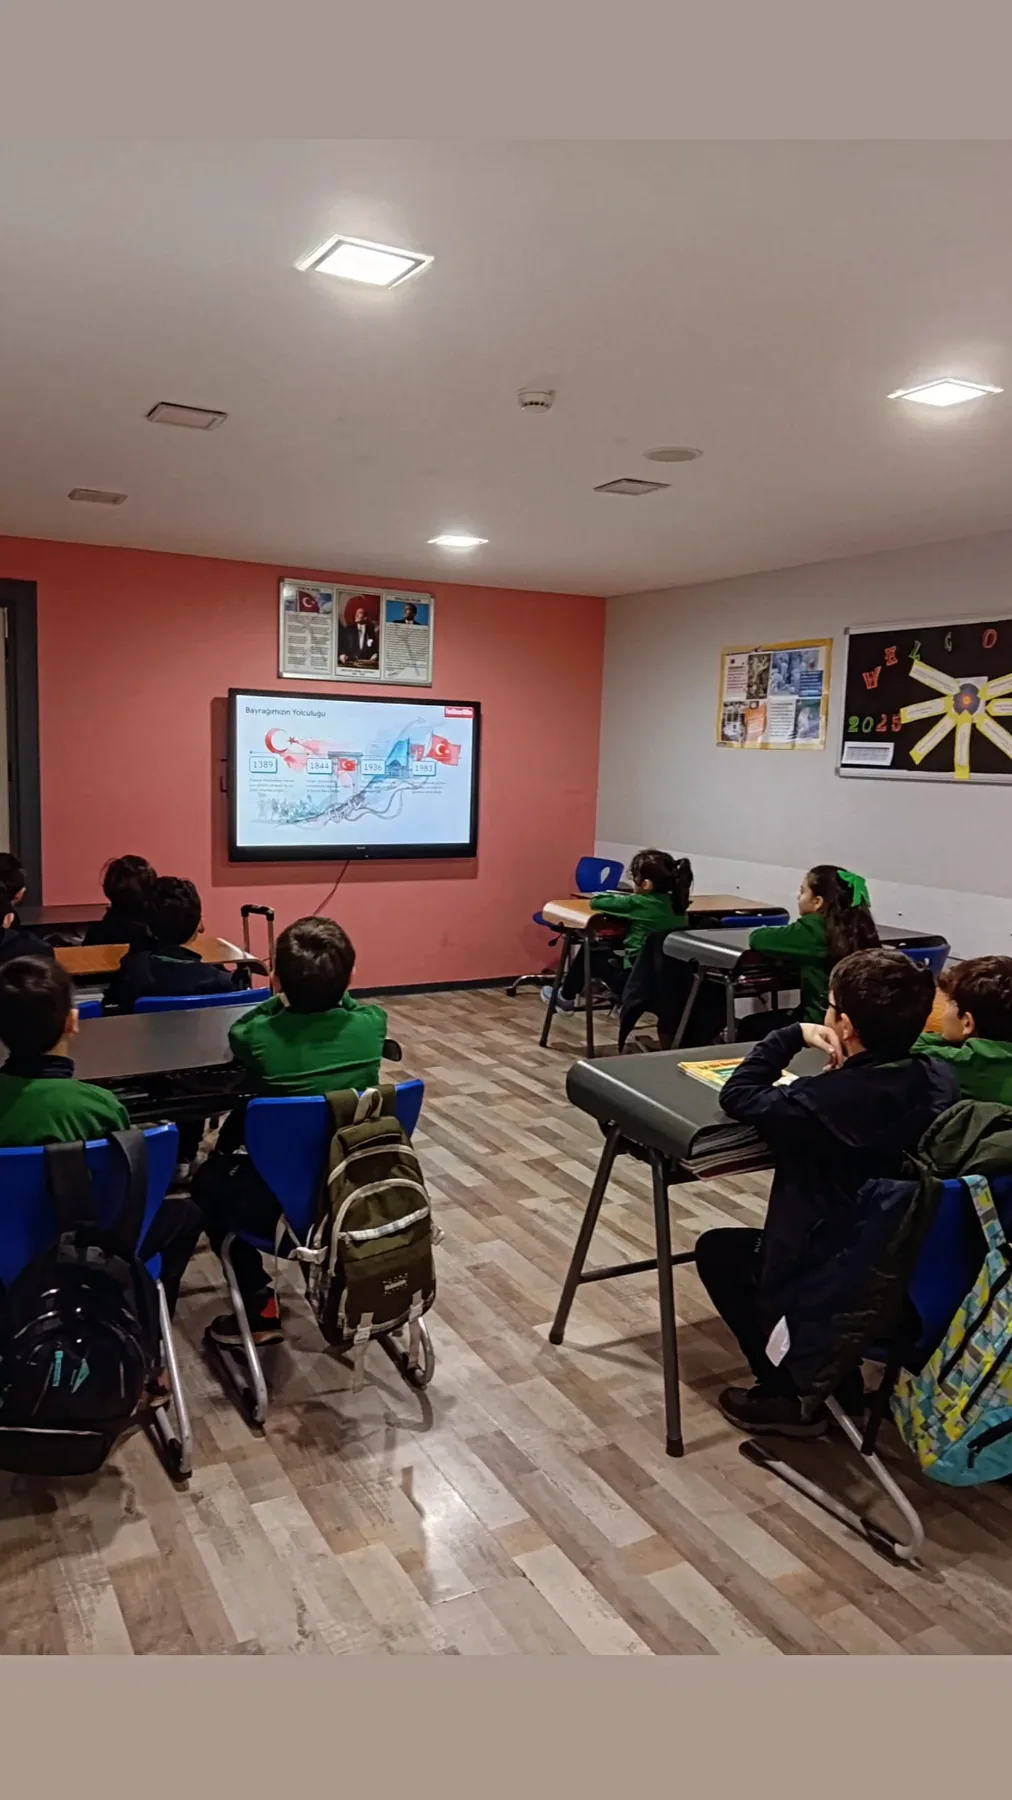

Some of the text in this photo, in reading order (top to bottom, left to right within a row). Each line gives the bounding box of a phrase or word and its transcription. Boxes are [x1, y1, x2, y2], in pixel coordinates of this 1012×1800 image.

[245, 706, 326, 719] Bayrağımızın Yolculuğu
[847, 713, 902, 733] 2025
[253, 760, 274, 769] 1389
[310, 762, 329, 770] 1844
[363, 763, 383, 771] 1936
[415, 764, 433, 772] 1983
